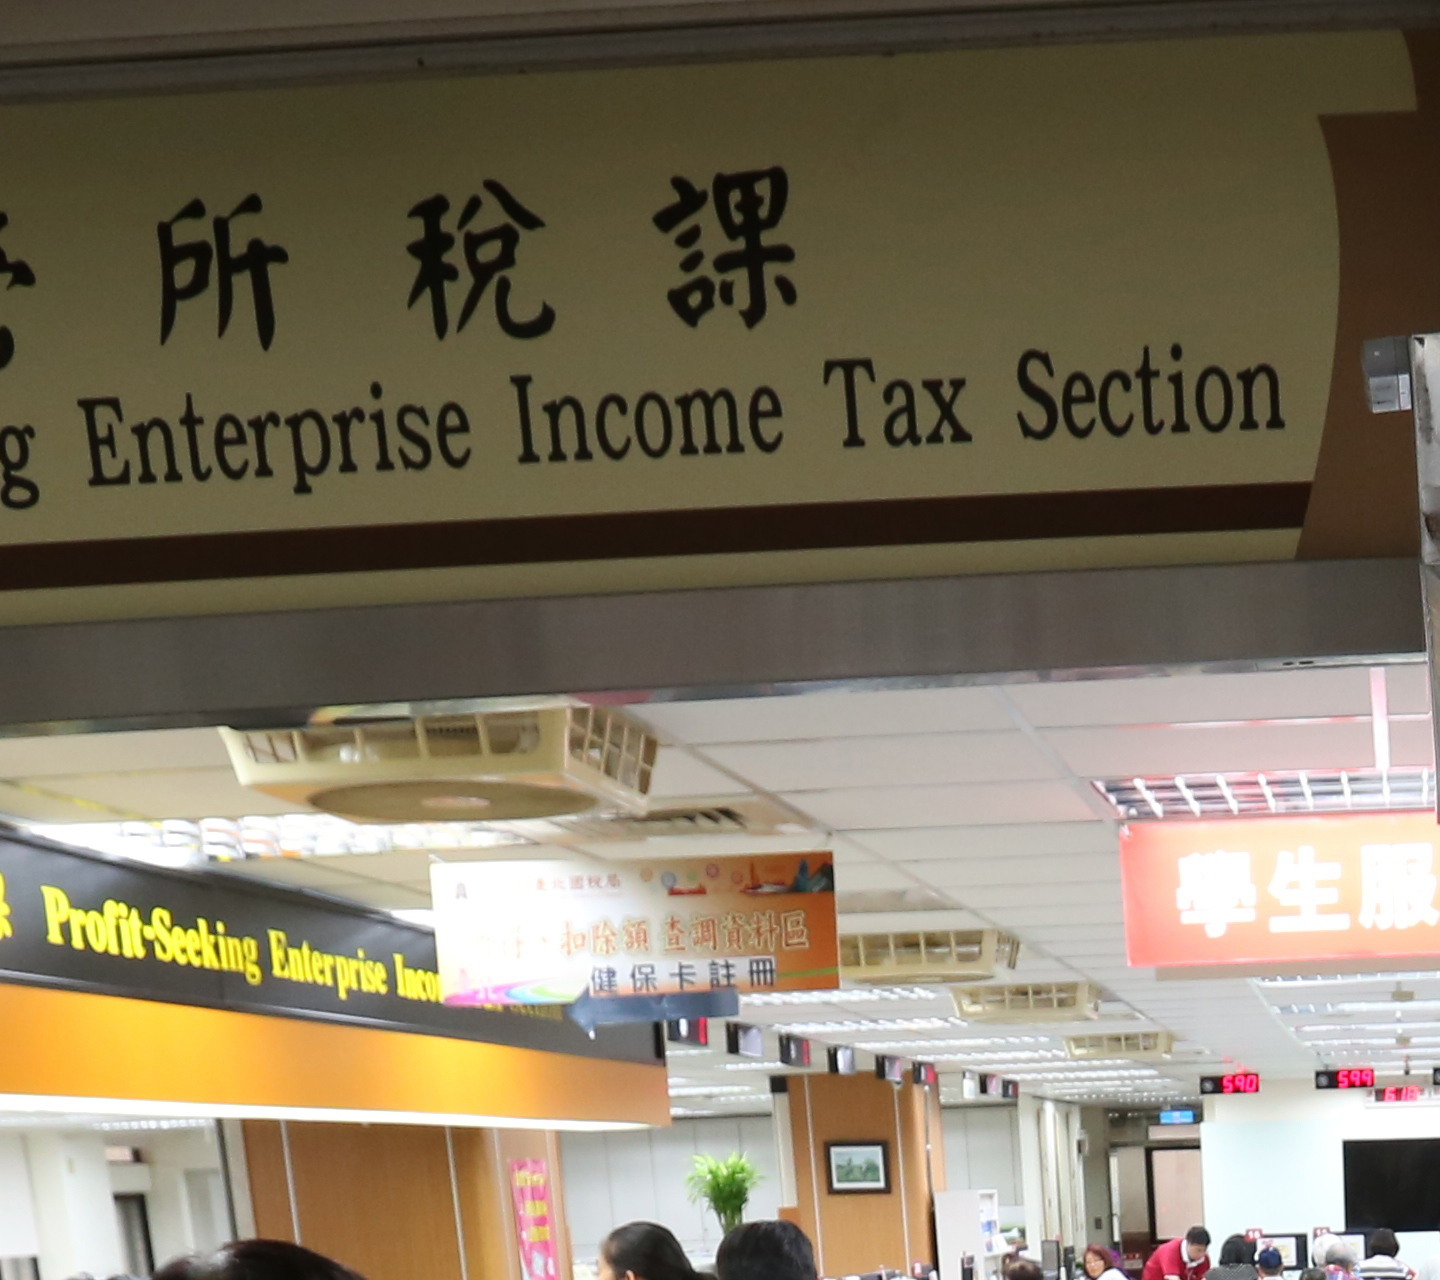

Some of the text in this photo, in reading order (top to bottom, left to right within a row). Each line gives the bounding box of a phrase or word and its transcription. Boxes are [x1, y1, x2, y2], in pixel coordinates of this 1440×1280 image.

[77, 381, 472, 494] Enterprise
[510, 374, 784, 463] Income
[823, 358, 973, 448] Tax
[1016, 343, 1286, 440] Section
[268, 928, 388, 999] Enterprise
[395, 953, 443, 1004] Inco
[590, 956, 777, 993] 健保卡註冊
[1222, 1074, 1258, 1093] 590
[1337, 1069, 1374, 1090] 599
